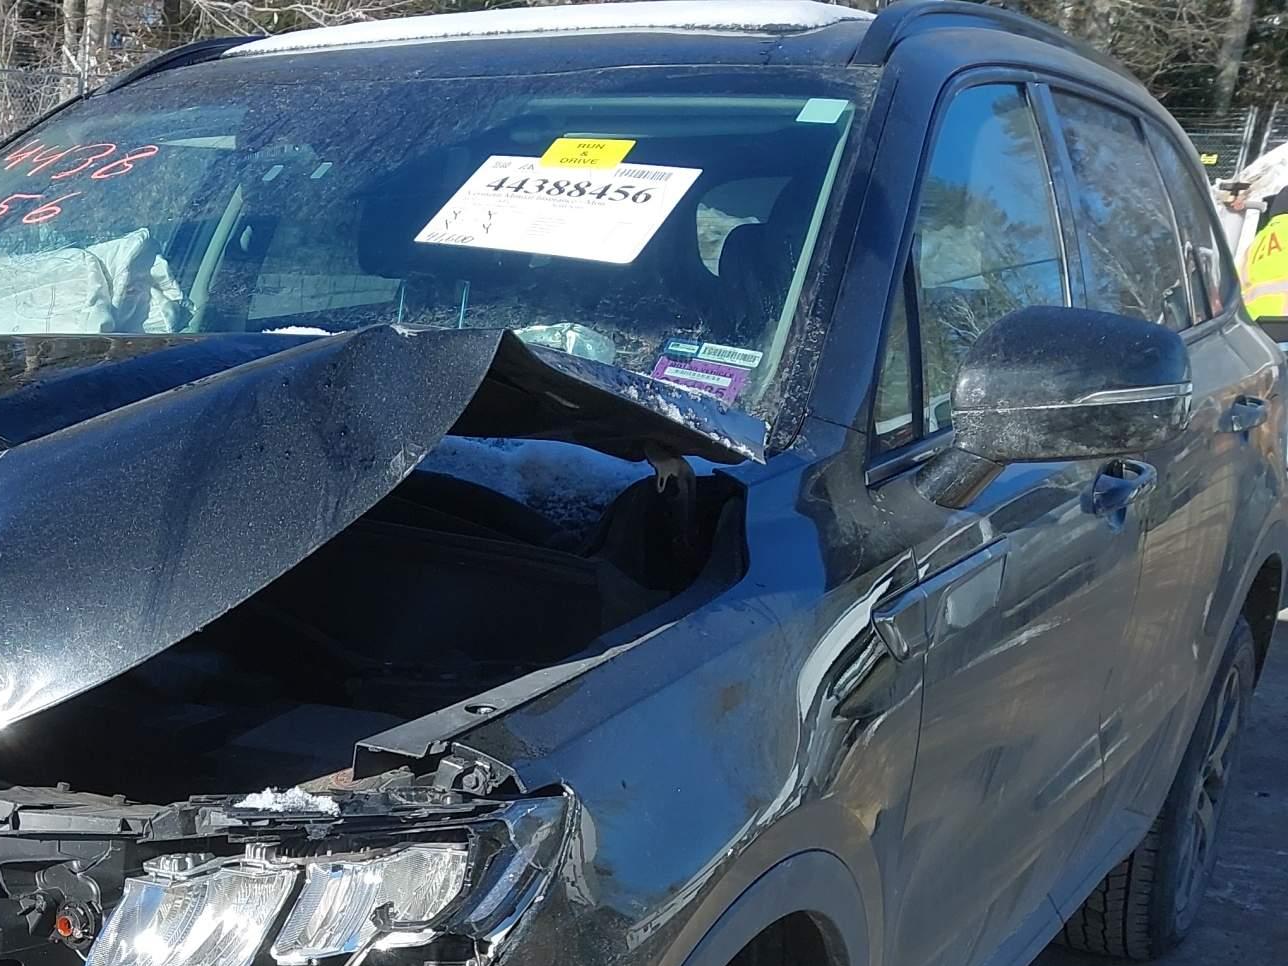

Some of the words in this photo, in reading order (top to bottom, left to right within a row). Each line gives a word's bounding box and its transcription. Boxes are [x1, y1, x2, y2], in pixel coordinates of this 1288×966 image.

[5, 139, 159, 179] 4438
[559, 157, 599, 165] DRIVE
[485, 176, 657, 204] 44388456
